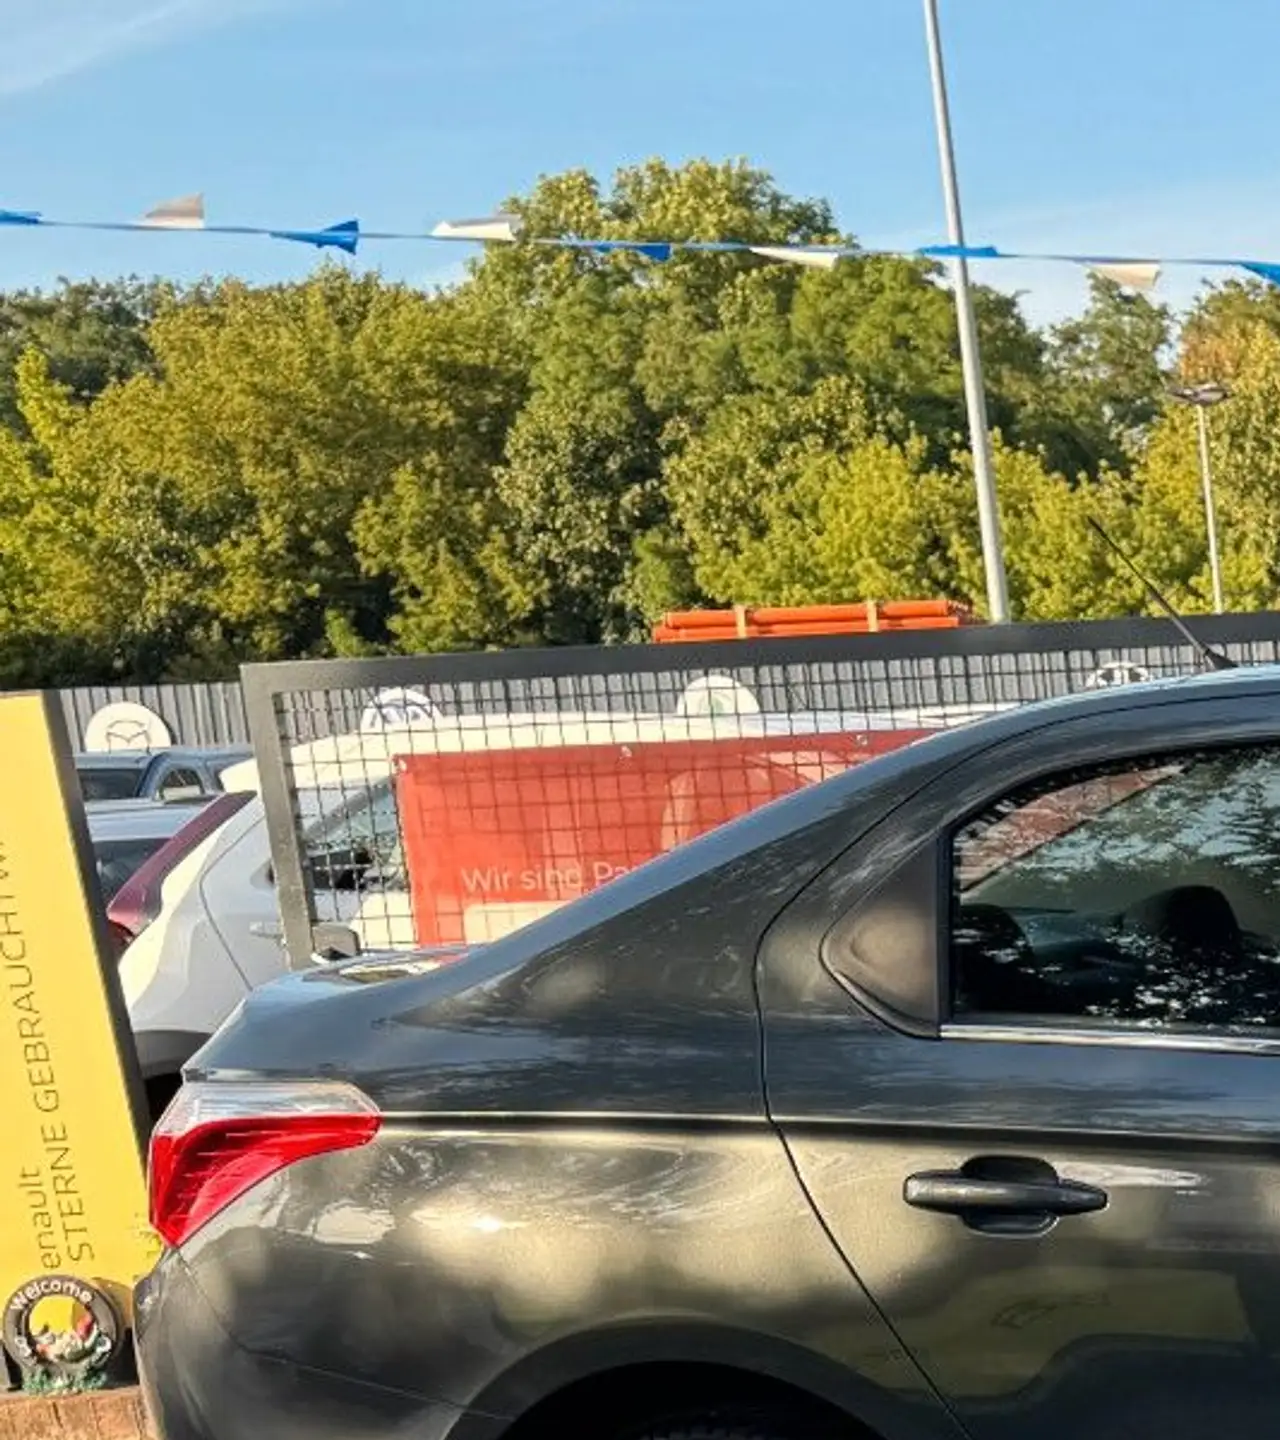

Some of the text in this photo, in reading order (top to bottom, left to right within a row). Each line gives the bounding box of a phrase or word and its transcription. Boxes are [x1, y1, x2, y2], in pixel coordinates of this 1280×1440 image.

[460, 866, 515, 892] Wir
[519, 862, 584, 891] sind
[19, 1166, 62, 1269] enault
[41, 1121, 95, 1261] STERNE
[10, 1279, 93, 1310] Welcome
